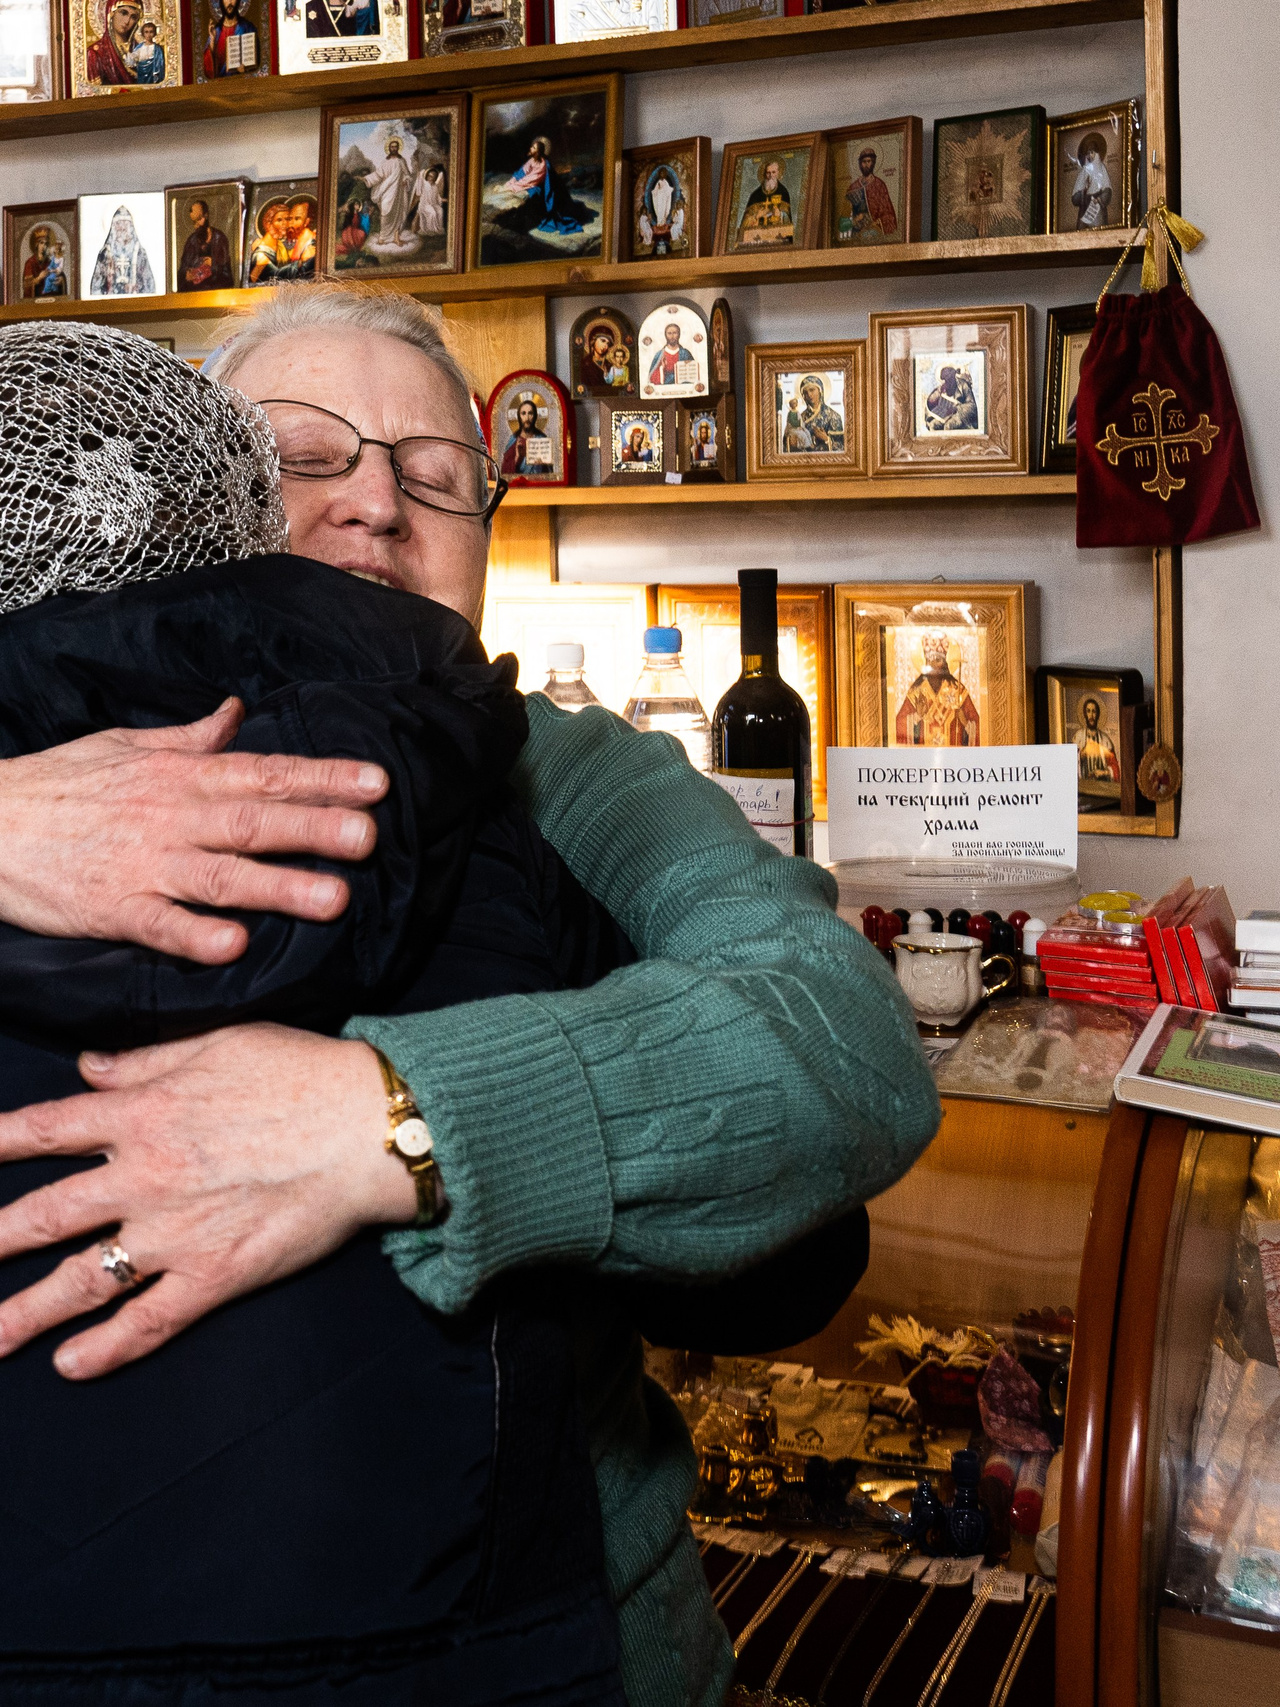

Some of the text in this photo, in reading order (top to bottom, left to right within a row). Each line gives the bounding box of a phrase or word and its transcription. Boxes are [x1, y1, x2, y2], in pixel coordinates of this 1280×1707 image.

[857, 765, 1043, 784] ПОЖЕРТВОВАНИЯ
[739, 789, 780, 813] тарь!
[858, 791, 1043, 812] на текущий ремонт
[923, 818, 980, 836] храма
[951, 841, 1045, 850] СПАСИ ВАС ГОСПОДИ
[951, 848, 1066, 859] ЗА ПОСИЛЬНУЮ ПОМОЩЬ!
